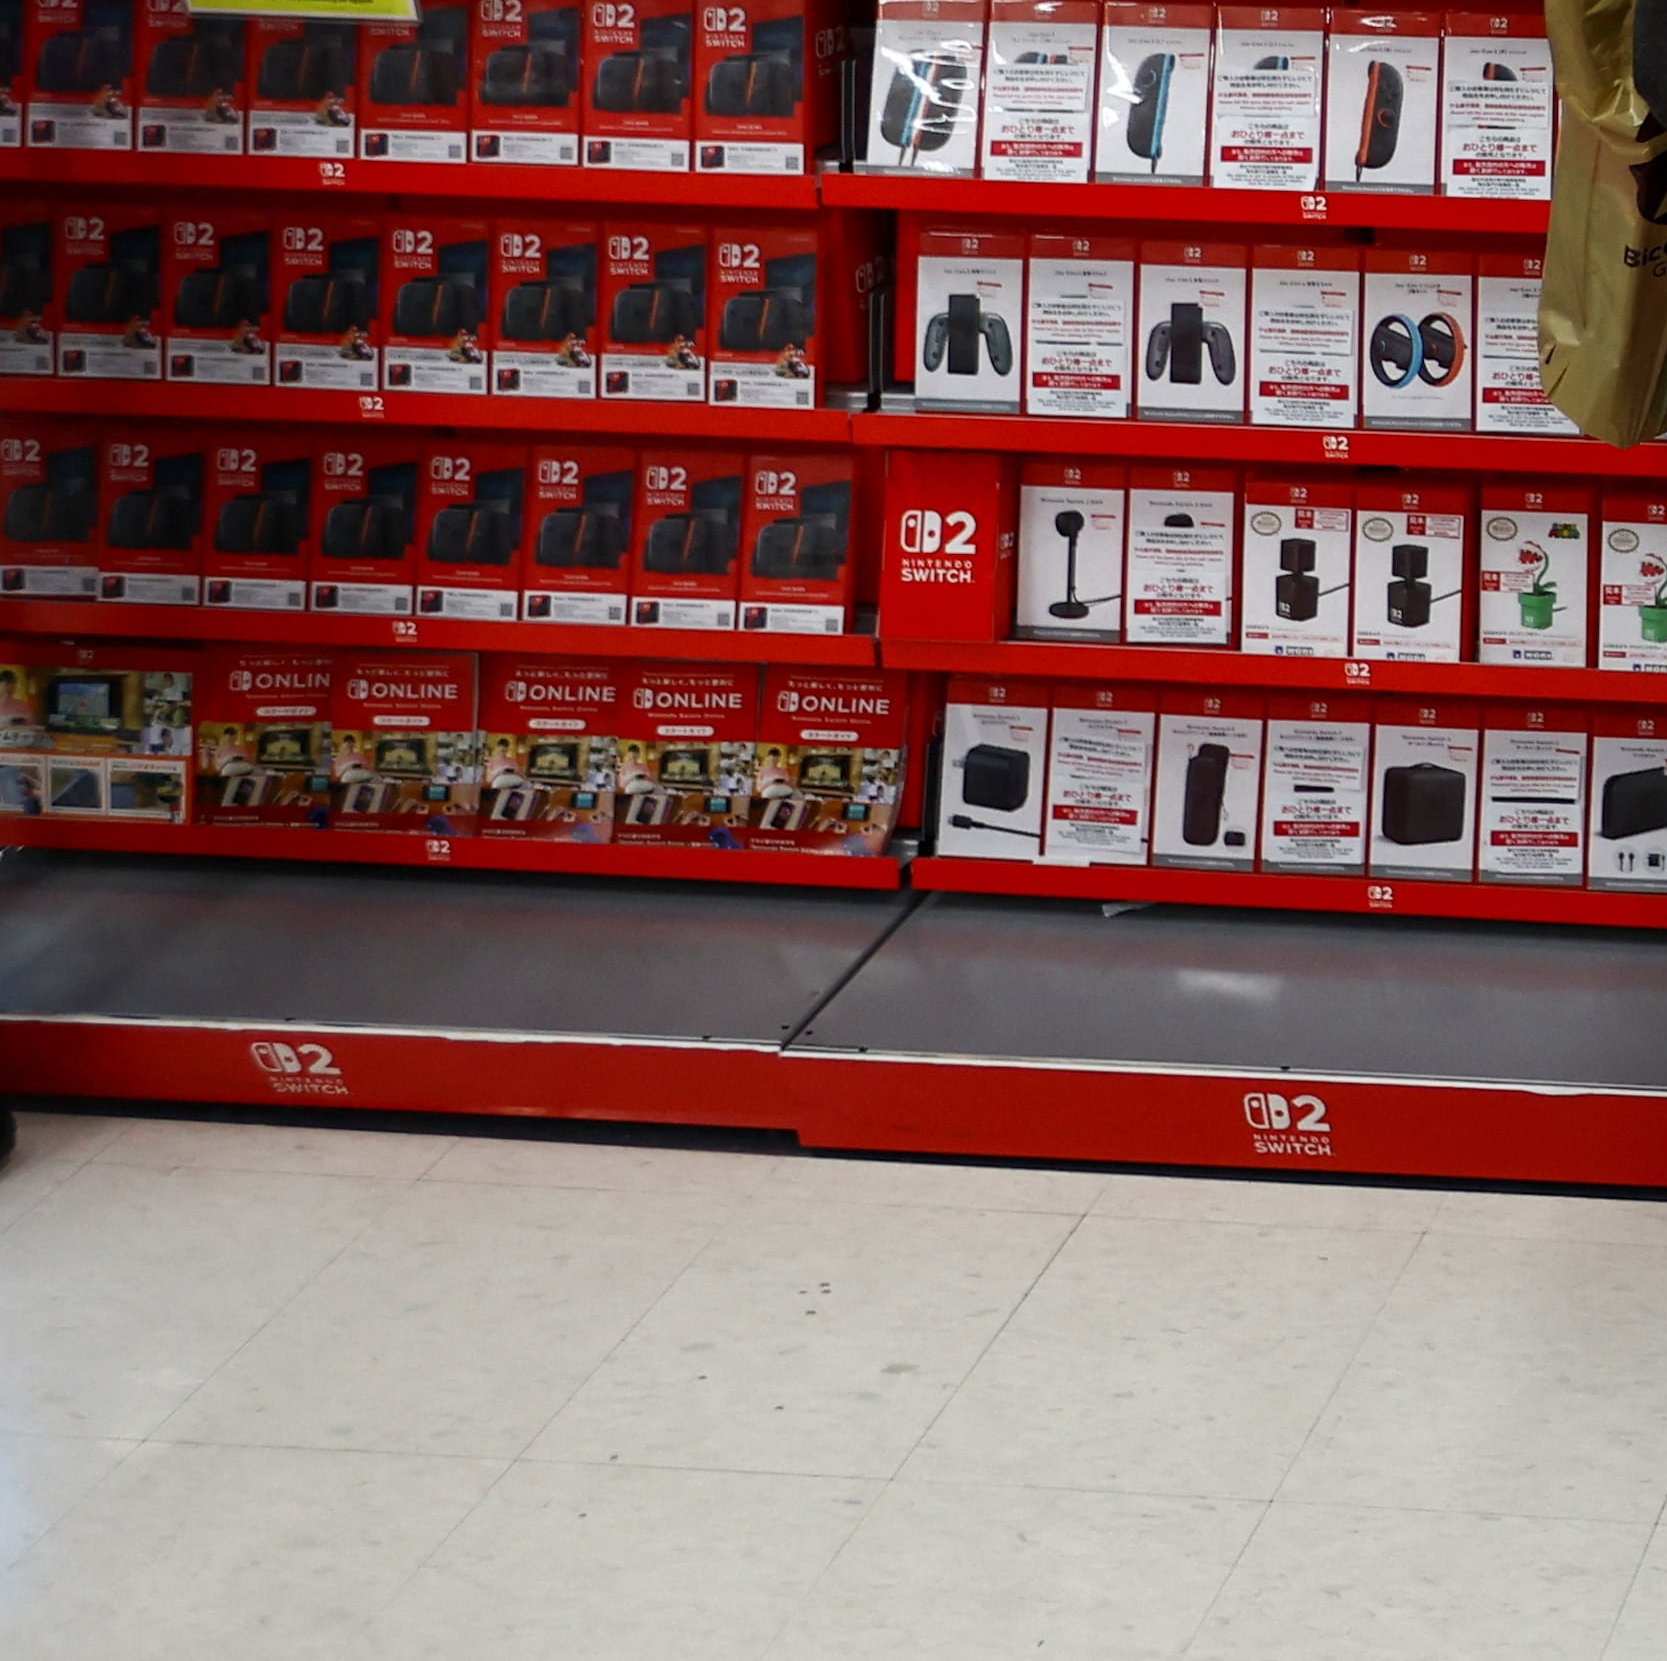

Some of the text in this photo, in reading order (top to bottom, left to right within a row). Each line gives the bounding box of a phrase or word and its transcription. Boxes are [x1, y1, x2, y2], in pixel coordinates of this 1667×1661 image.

[945, 511, 976, 554] 2
[902, 559, 972, 570] NINTENDO
[902, 568, 971, 583] SWITCH
[368, 679, 459, 702] ONLINE
[799, 695, 890, 717] ONLINE
[296, 1044, 341, 1074] 2
[273, 1081, 348, 1094] SWITCH
[1292, 1095, 1330, 1131] 2
[1253, 1134, 1329, 1145] NINTENDO
[1255, 1142, 1331, 1155] SWITCH
